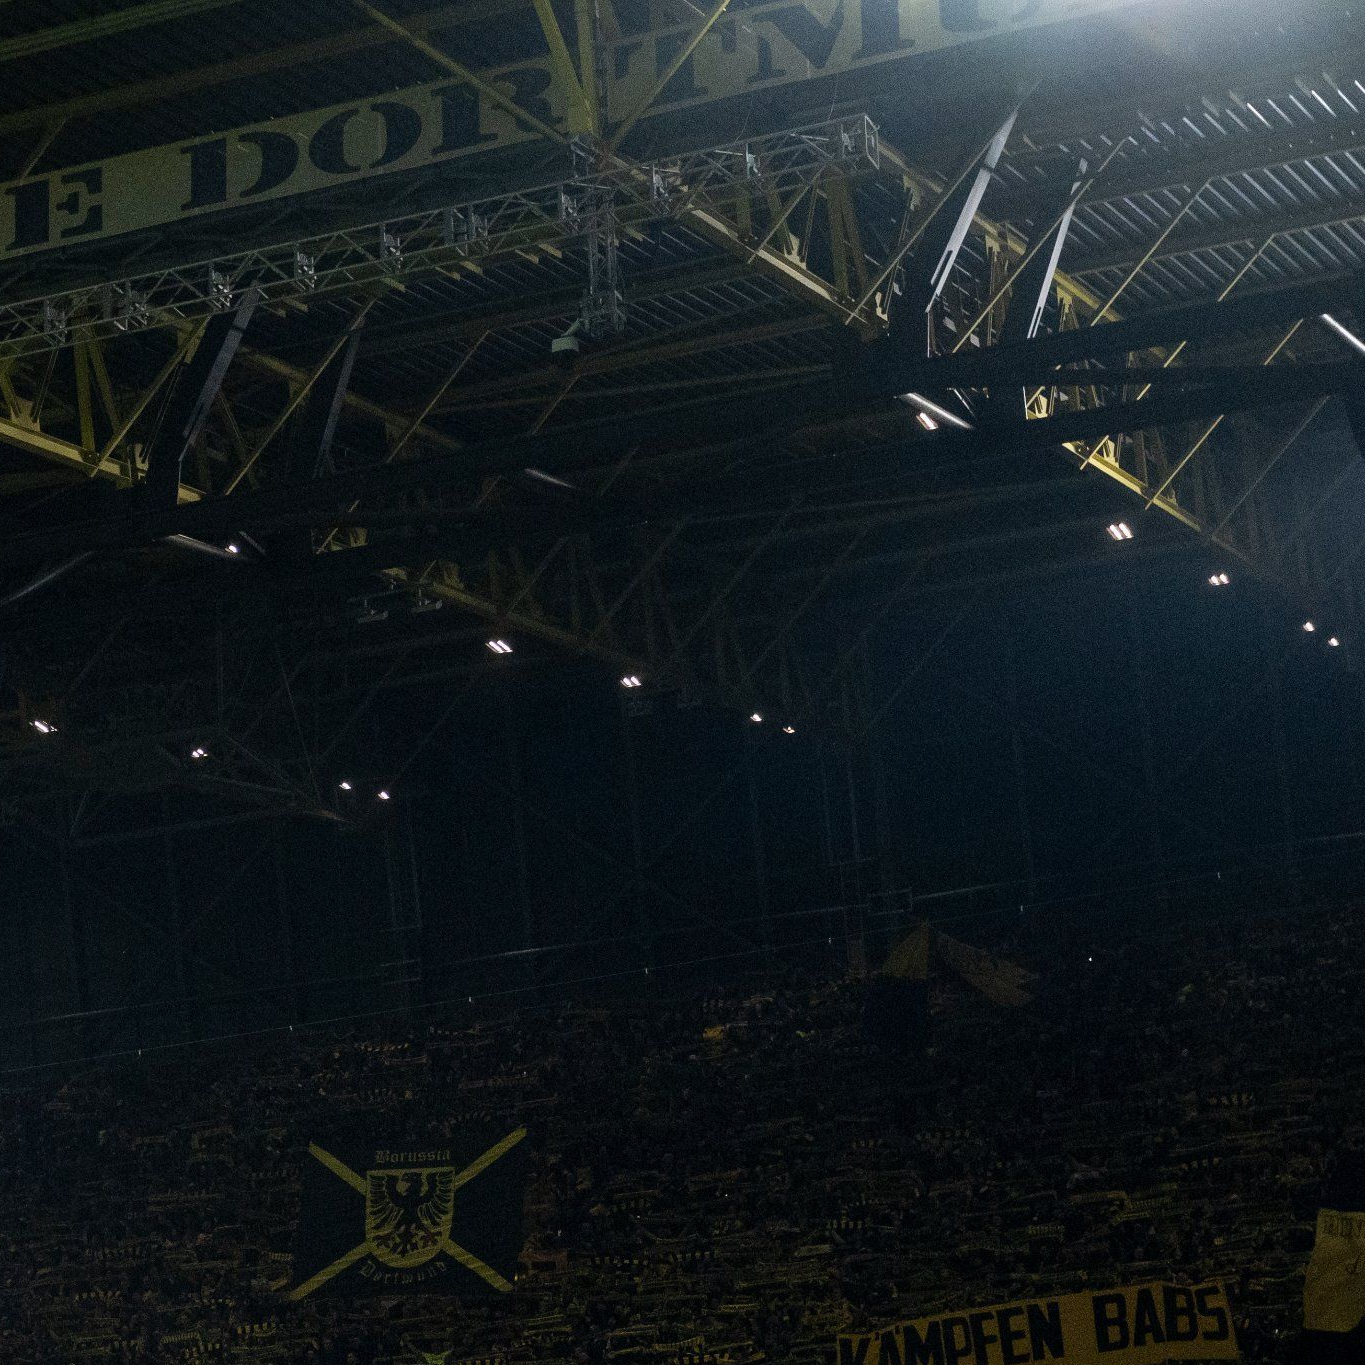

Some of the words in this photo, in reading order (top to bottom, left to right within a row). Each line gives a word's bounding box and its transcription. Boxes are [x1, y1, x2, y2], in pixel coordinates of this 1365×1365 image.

[374, 1149, 452, 1164] Borussia
[356, 1260, 448, 1285] Dortmund
[1093, 1283, 1230, 1353] BABS
